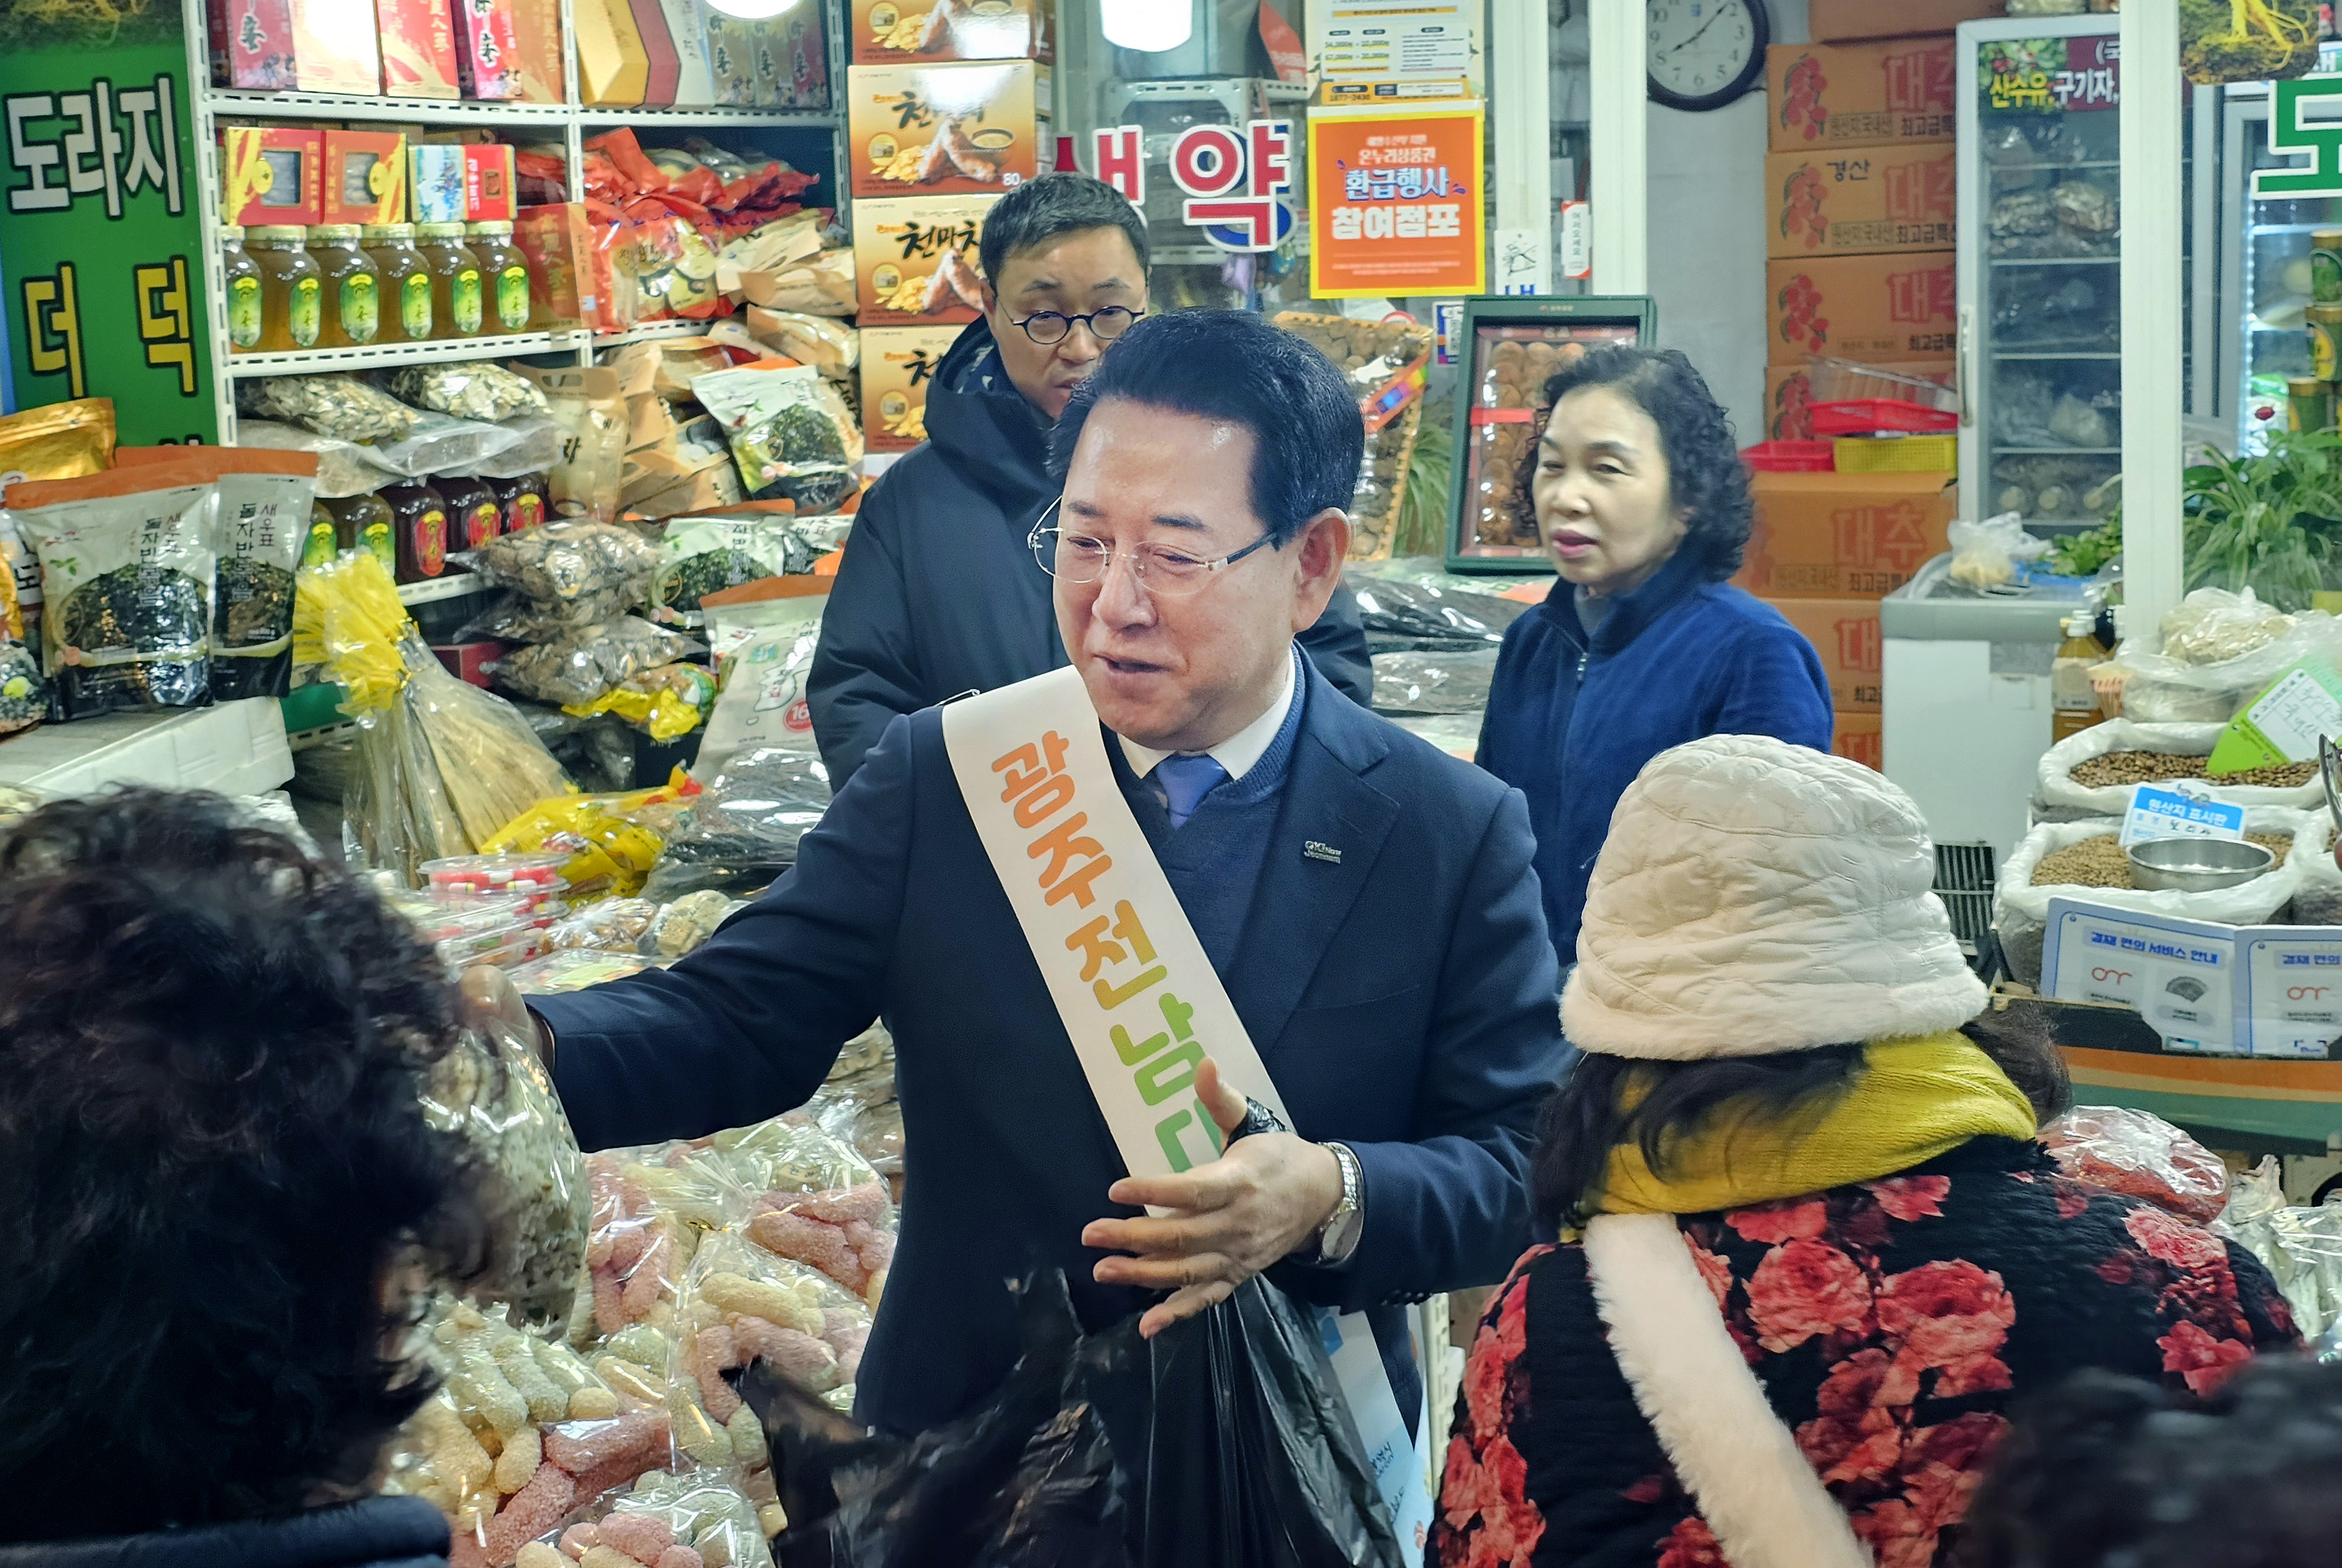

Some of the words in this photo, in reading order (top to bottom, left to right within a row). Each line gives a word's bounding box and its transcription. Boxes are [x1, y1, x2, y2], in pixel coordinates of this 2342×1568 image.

[5, 74, 184, 220] 도라지
[1001, 173, 1022, 186] 80
[1345, 166, 1450, 202] 환급행사
[1826, 158, 1871, 182] 경산
[1332, 204, 1461, 240] 참여점포
[259, 503, 278, 547] 새우표
[1835, 504, 1925, 567] 대추
[2148, 798, 2186, 818] 원산지
[2187, 808, 2228, 827] 표시판
[2148, 941, 2187, 960] 서비스
[2190, 949, 2219, 965] 안내
